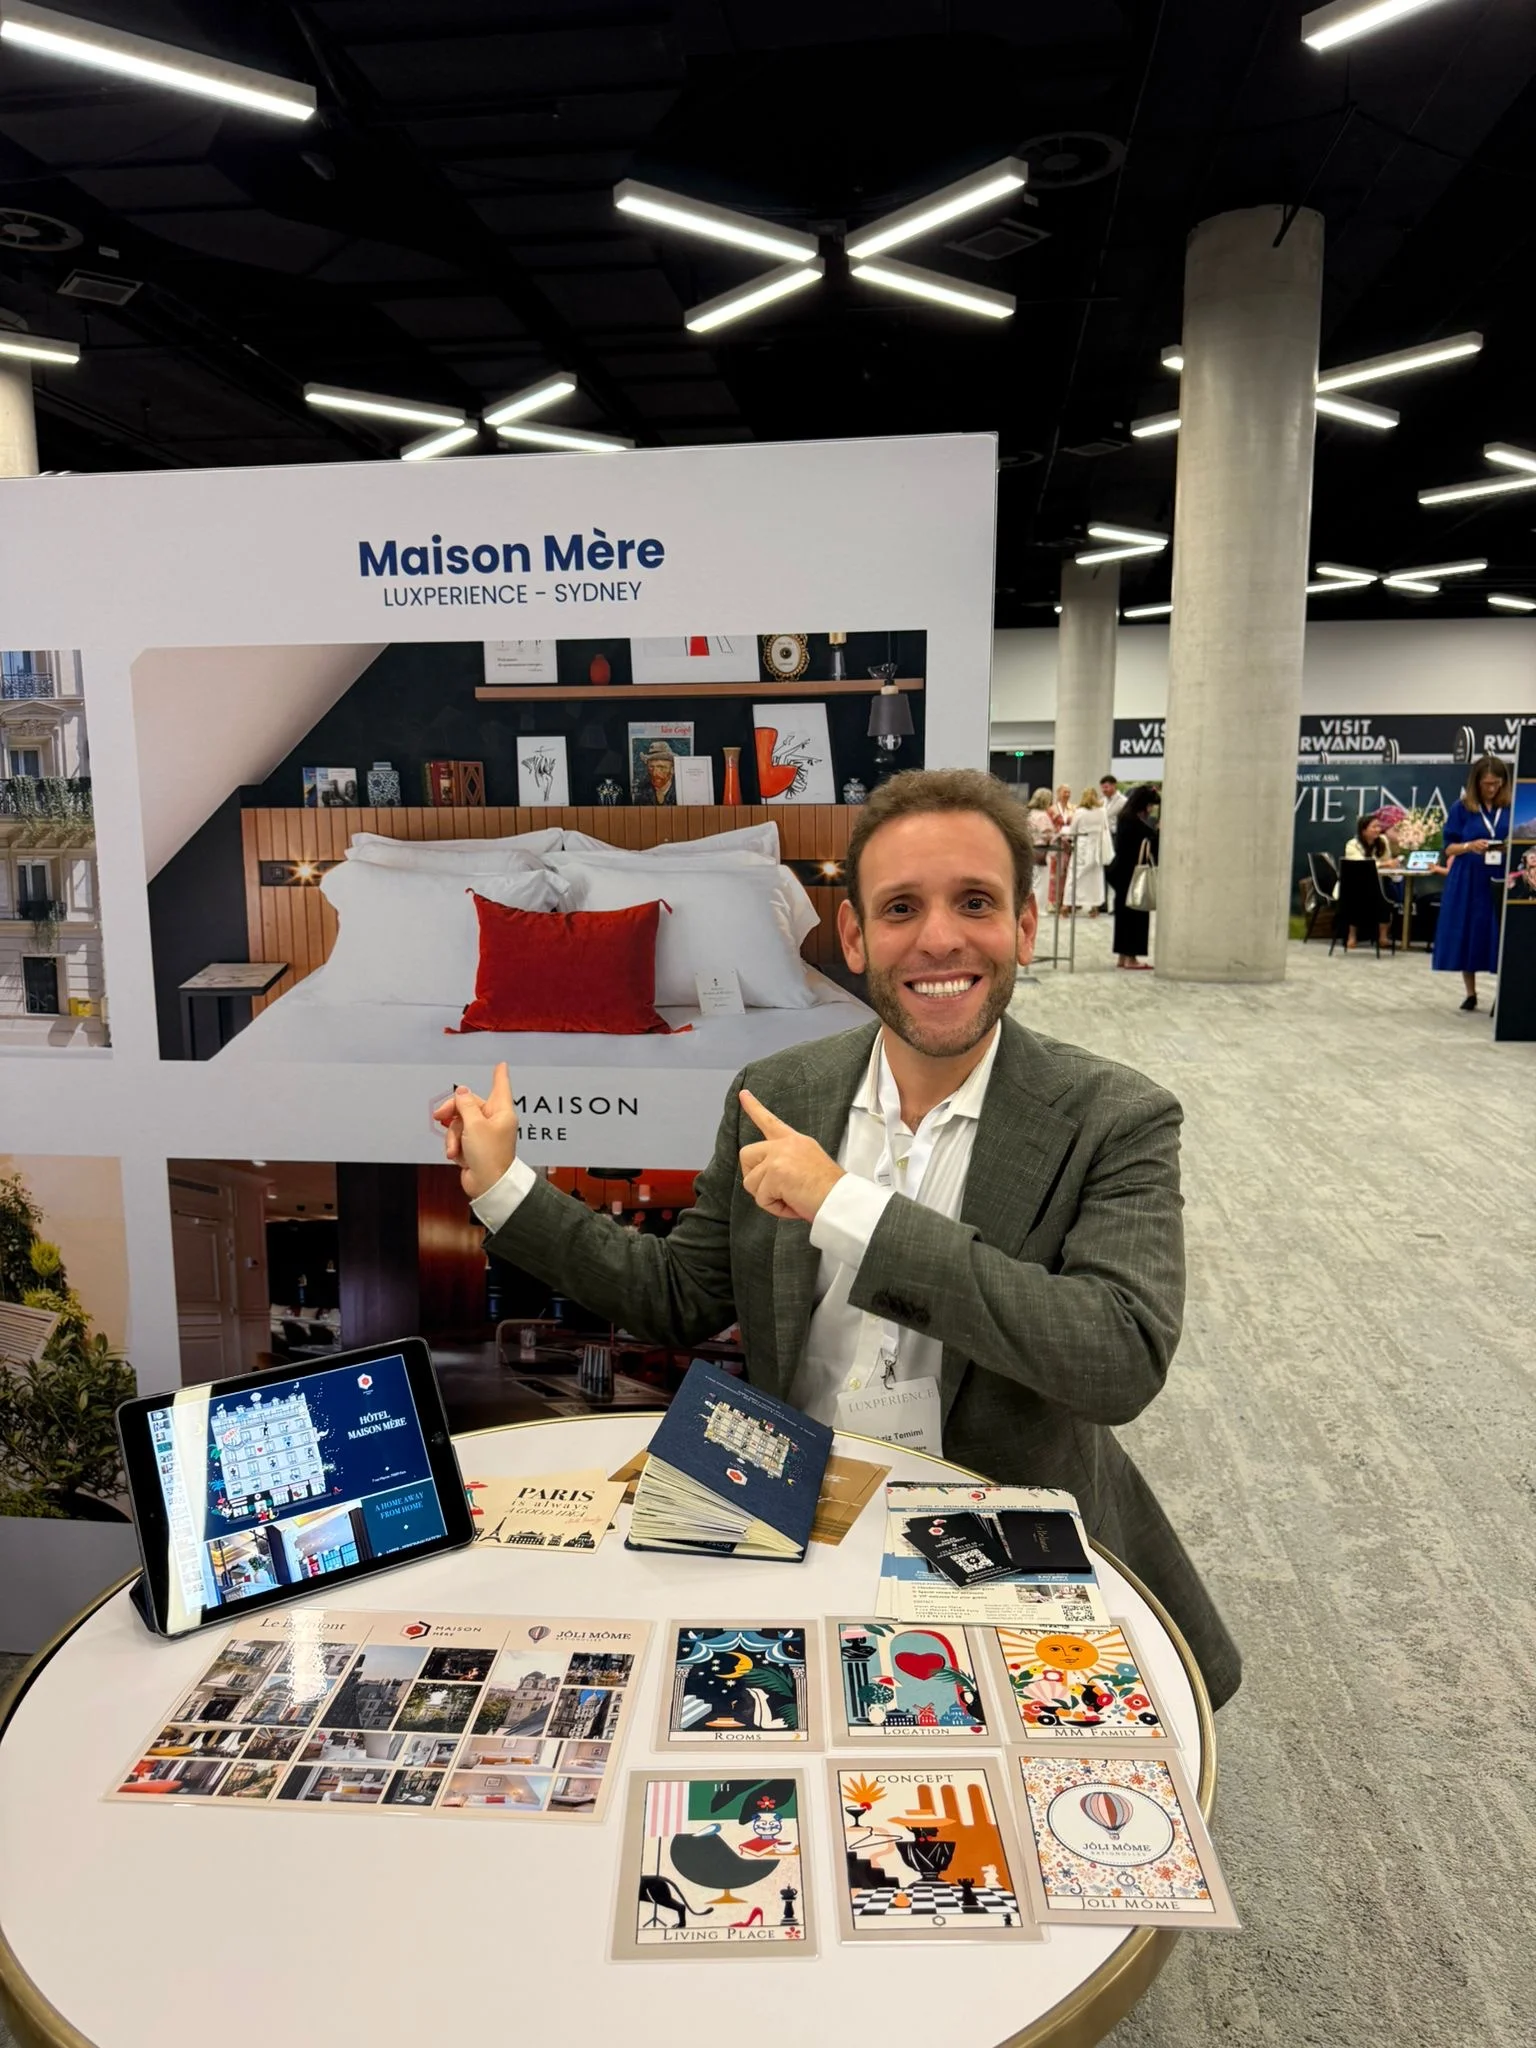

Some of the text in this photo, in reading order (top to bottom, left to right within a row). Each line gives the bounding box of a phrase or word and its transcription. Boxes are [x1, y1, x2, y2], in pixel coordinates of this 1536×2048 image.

[358, 527, 665, 576] Maison Mère
[383, 584, 528, 607] LUXPERIENCE
[554, 581, 642, 603] SYDNEY
[1320, 719, 1371, 735] VISIT
[1301, 735, 1386, 751] RWANDA
[848, 1389, 934, 1413] LUXPERIENCE
[359, 1410, 391, 1425] HÔTEL
[347, 1417, 407, 1440] MAISON MÈRE
[518, 1487, 595, 1502] PARIS
[534, 1500, 589, 1510] always
[260, 1618, 279, 1628] Le
[588, 1630, 632, 1640] MÔME
[714, 1732, 762, 1740] ROOMS
[883, 1727, 950, 1735] LOCATION
[1055, 1728, 1136, 1737] MM FAMILY
[876, 1774, 954, 1784] CONCEPT
[1112, 1841, 1151, 1852] MÔME
[663, 1927, 775, 1941] LIVING PLACE
